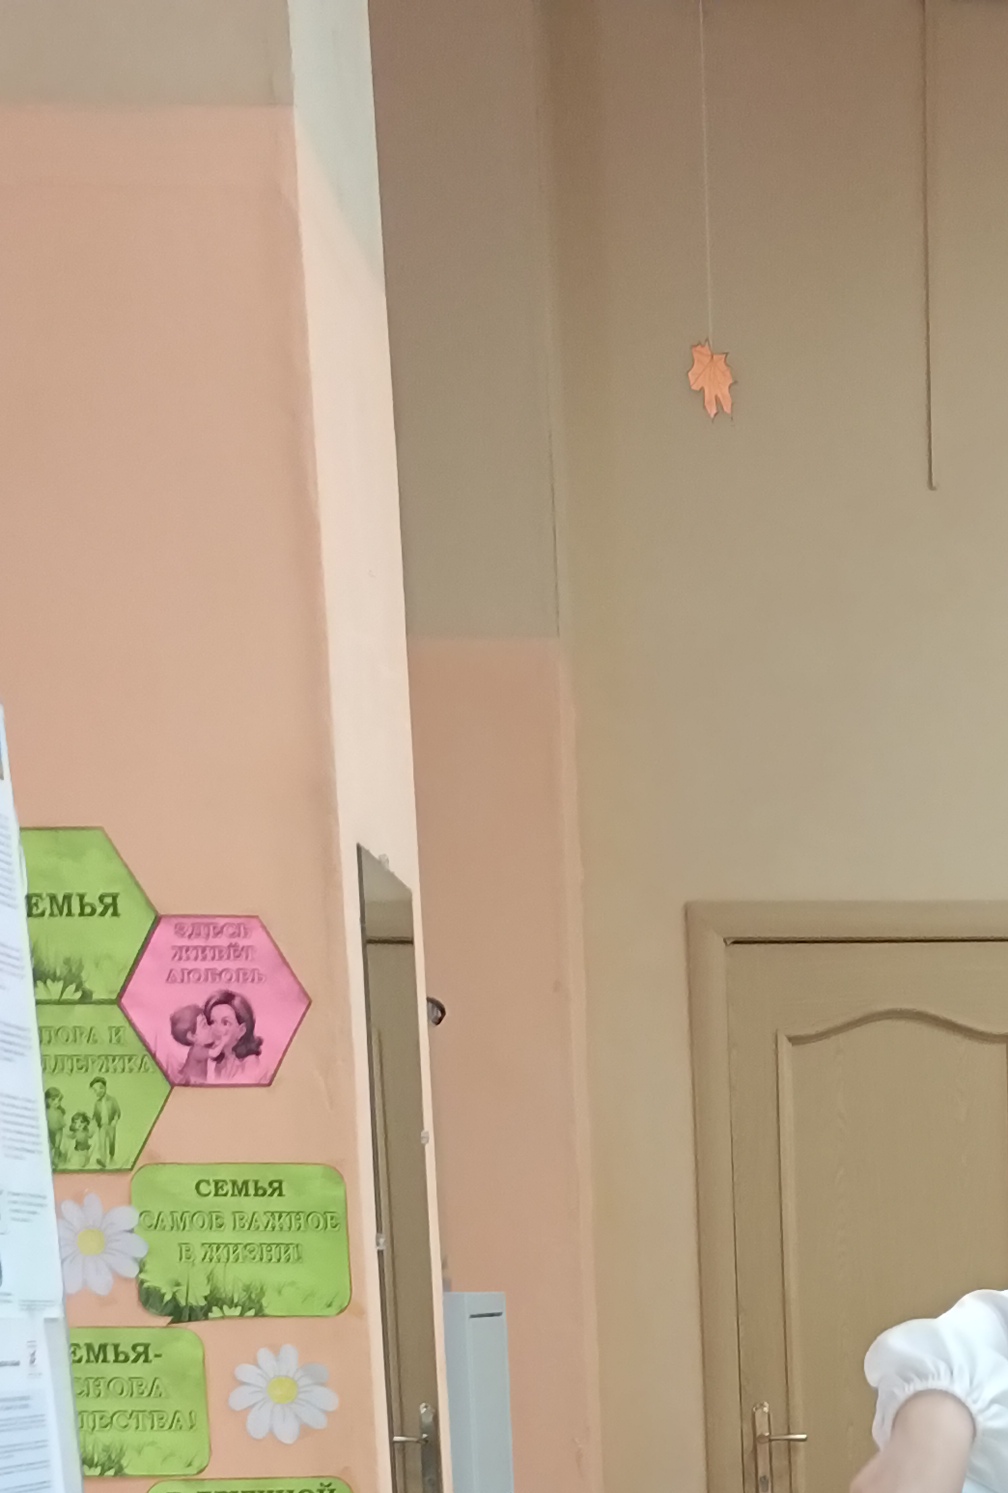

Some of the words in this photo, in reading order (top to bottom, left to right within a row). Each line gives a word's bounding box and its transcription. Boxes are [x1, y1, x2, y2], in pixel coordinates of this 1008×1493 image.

[25, 891, 121, 918] ЕМЬЯ
[174, 921, 252, 940] ЗДЕСЬ
[171, 942, 256, 961] ЖИВЁТ
[165, 967, 267, 984] ЛЮБОВЬ
[39, 1026, 98, 1045] ПОРА
[194, 1179, 286, 1198] СЕМЬЯ
[138, 1210, 226, 1232] САМОЕ
[232, 1210, 340, 1232] ВАЖНОЕ
[178, 1243, 193, 1263] В
[201, 1243, 303, 1263] ЖИЗНИ!
[70, 1342, 163, 1364] ЕМЬЯ-
[74, 1376, 168, 1398] СНОВА
[78, 1409, 197, 1435] ЩЕСТВА!
